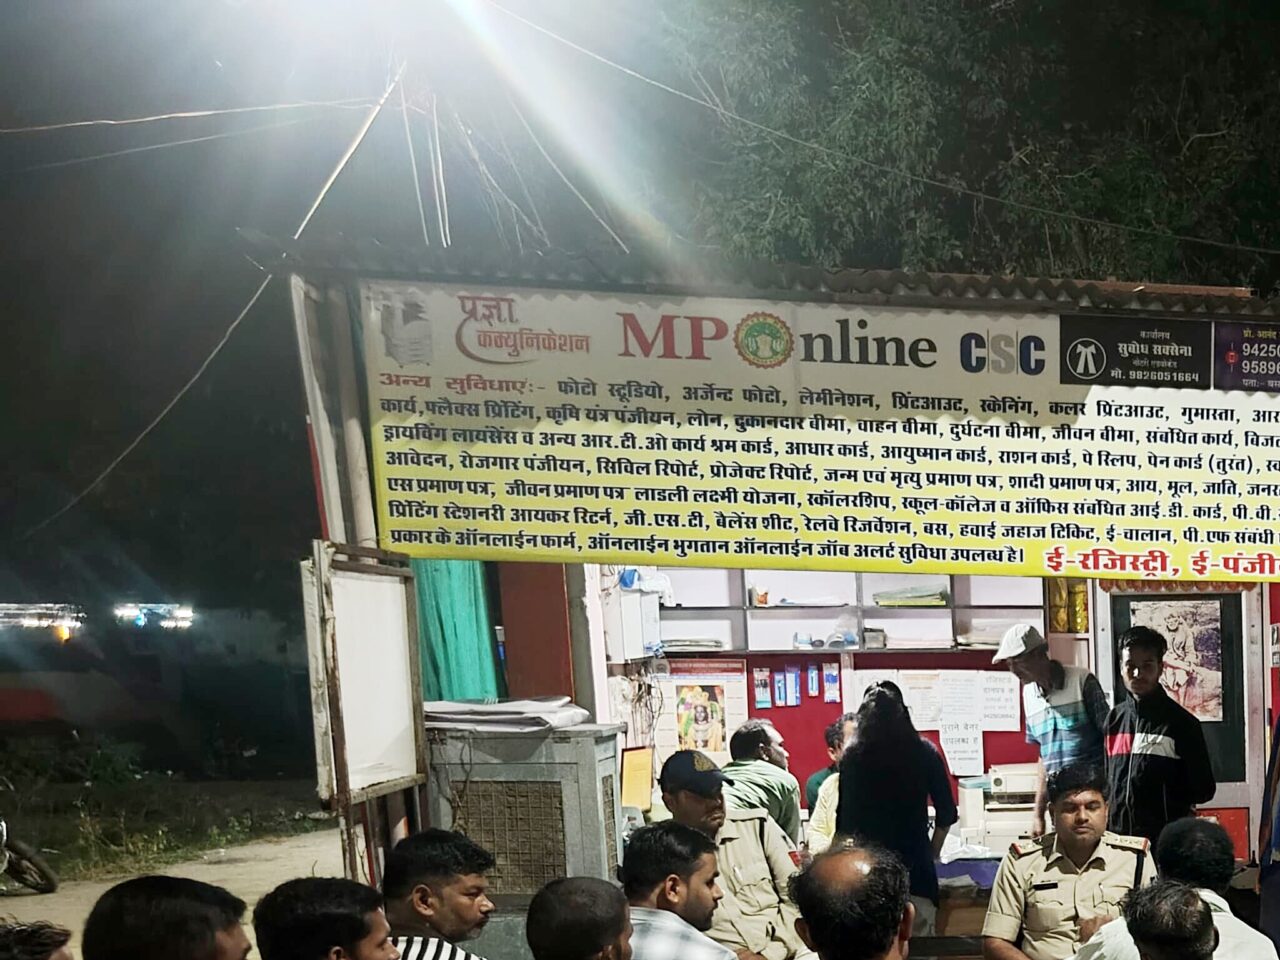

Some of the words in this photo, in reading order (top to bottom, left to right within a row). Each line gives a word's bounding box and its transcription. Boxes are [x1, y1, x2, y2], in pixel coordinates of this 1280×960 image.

[1118, 341, 1149, 357] सुबोध
[1152, 343, 1192, 357] सक्सेना
[1140, 329, 1170, 339] कार्यालय
[1129, 371, 1199, 382] 9826051664
[379, 373, 431, 388] अन्य
[558, 378, 597, 397] फोटो
[683, 383, 733, 401] अर्जेन्ट
[742, 386, 788, 407] फोटो,
[1048, 401, 1087, 416] कलर
[1181, 405, 1240, 425] गुमास्ता,
[389, 501, 437, 519] प्रिंटिंग
[443, 503, 505, 522] स्टेशनरी
[511, 508, 570, 524] आयकर
[573, 507, 619, 528] रिटर्न,
[716, 511, 757, 529] बैलेंस
[762, 514, 799, 532] शीट,
[803, 513, 840, 533] रेलवे
[844, 515, 917, 537] रिजर्वेशन,
[923, 523, 954, 538] बस,
[960, 522, 996, 539] हवाई
[1001, 526, 1046, 539] जहाज
[1050, 523, 1101, 543] टिकिट,
[1105, 526, 1177, 544] ई-चालान,
[1183, 527, 1229, 544] पी.एफ
[1235, 527, 1273, 545] संबंधी
[391, 530, 432, 544] प्रकार
[435, 527, 450, 545] के
[455, 528, 538, 548] ऑनलाईन
[541, 533, 582, 551] फार्म,
[588, 533, 669, 554] ऑनलाईन
[673, 537, 729, 557] भुगतान
[734, 537, 813, 557] ऑनलाईन
[817, 539, 850, 557] जॉब
[854, 543, 895, 558] अलर्ट
[899, 544, 946, 563] सुविधा
[951, 550, 1003, 563] उपलब्ध
[1046, 545, 1181, 578] ई-रजिस्ट्री,
